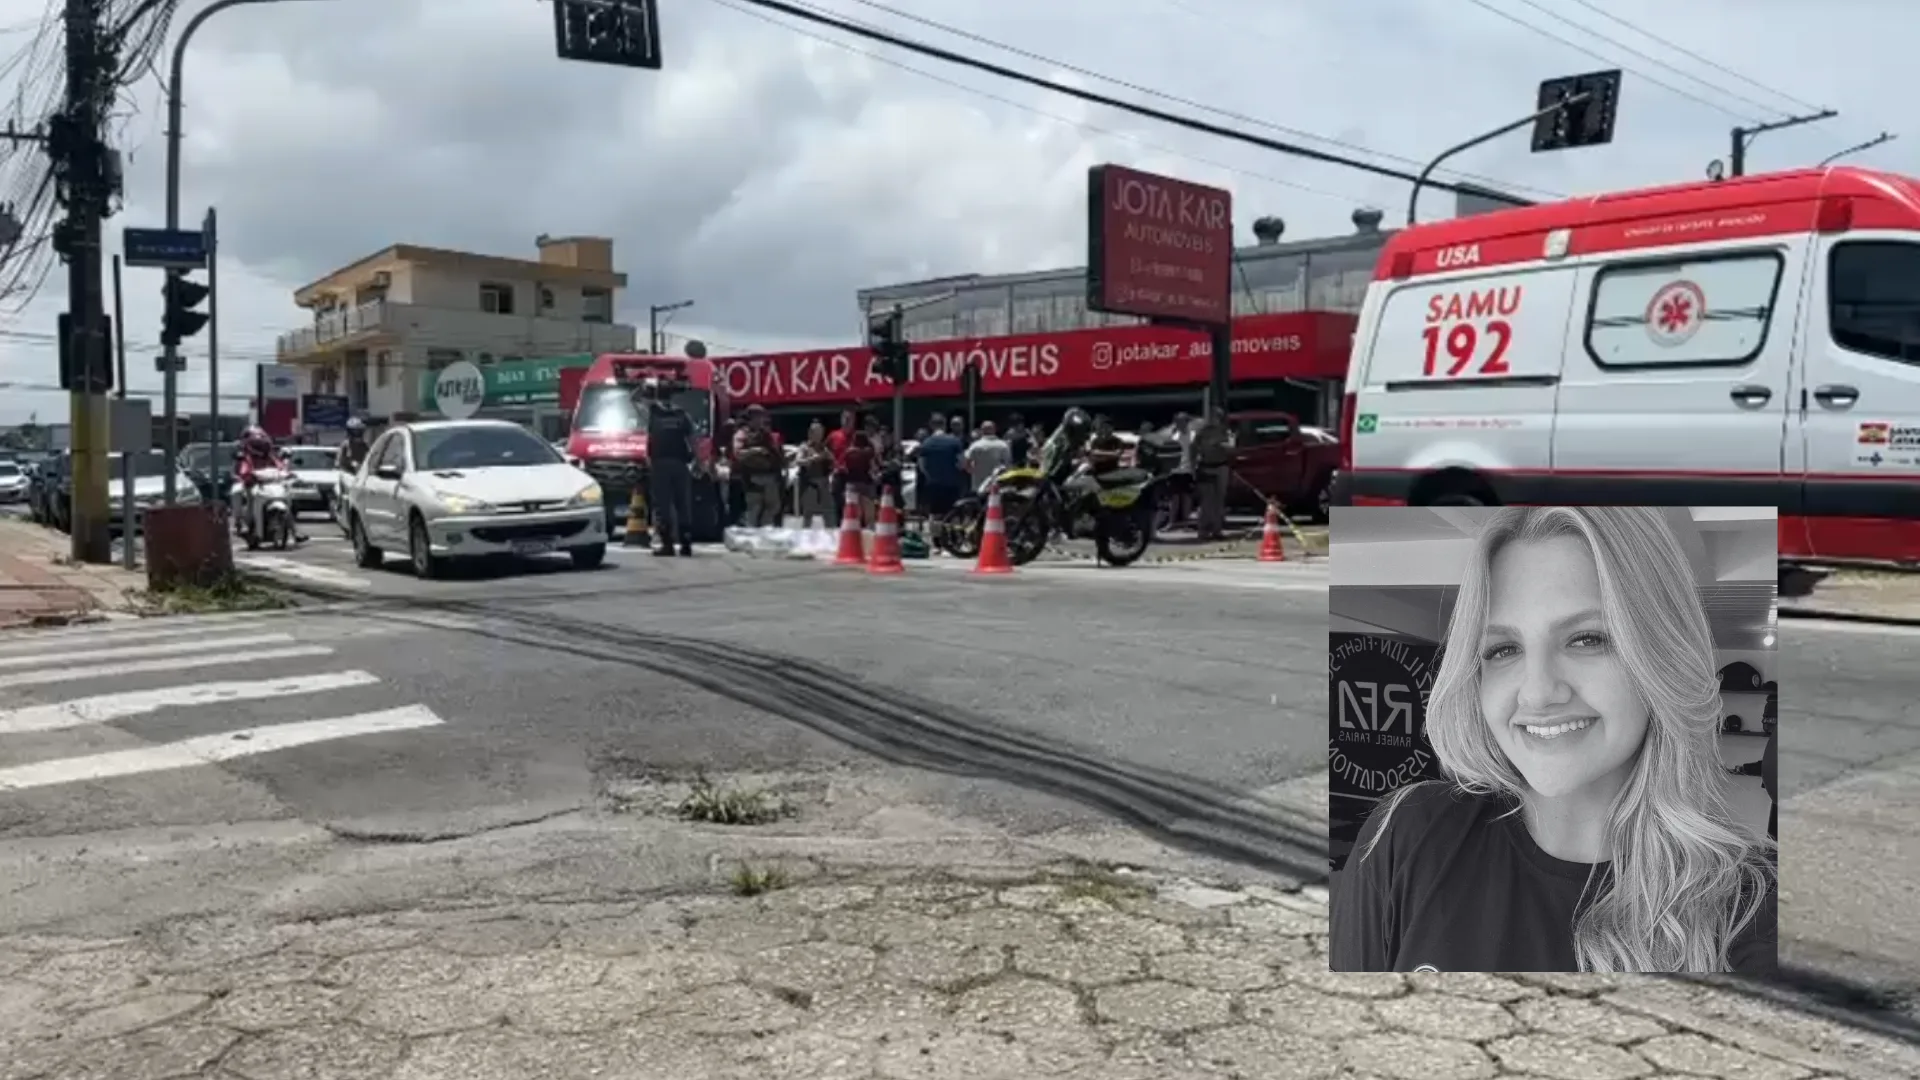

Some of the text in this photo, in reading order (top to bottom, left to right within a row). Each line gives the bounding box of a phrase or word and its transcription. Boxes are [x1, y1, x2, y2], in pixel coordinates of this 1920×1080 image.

[1112, 178, 1225, 229] JOTA KAR
[1436, 243, 1480, 268] USA
[1425, 285, 1522, 323] SAMU
[790, 354, 850, 395] KAR
[864, 341, 1060, 386] ATOMÓVEIS
[1116, 334, 1301, 366] jotakar_aumoveis
[1422, 320, 1512, 377] 192
